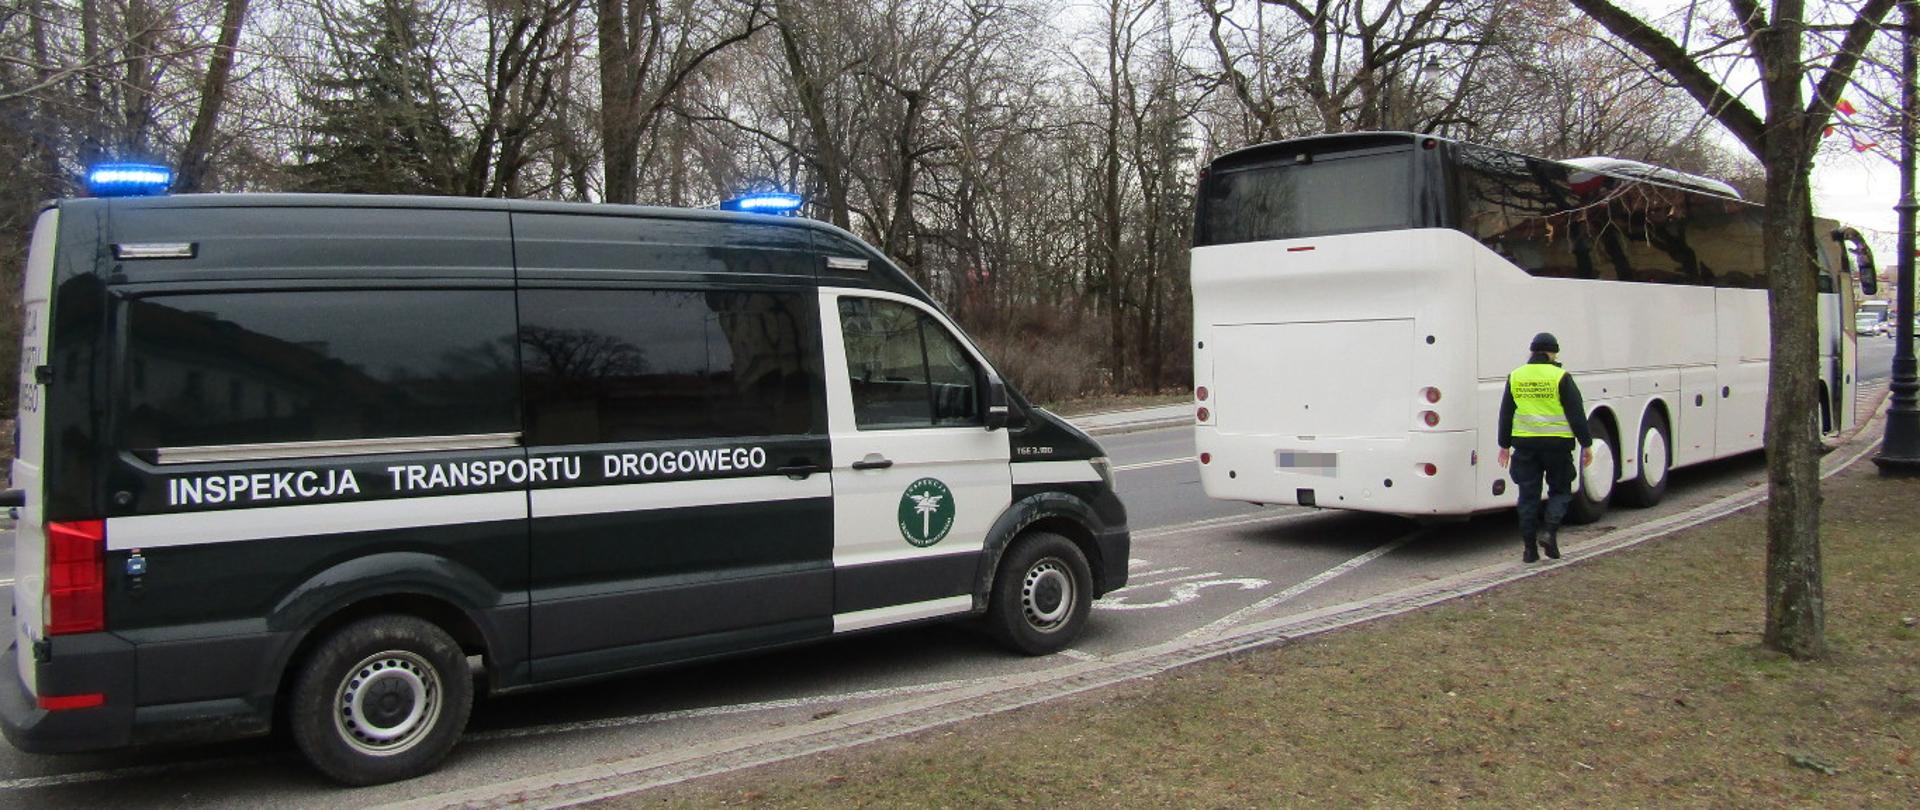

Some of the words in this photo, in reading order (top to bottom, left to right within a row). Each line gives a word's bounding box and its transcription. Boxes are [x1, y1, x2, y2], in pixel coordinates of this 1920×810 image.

[169, 469, 360, 506] INSPEKCJA
[388, 456, 581, 491] TRANSPORTU
[604, 447, 766, 478] DROGOWEGO
